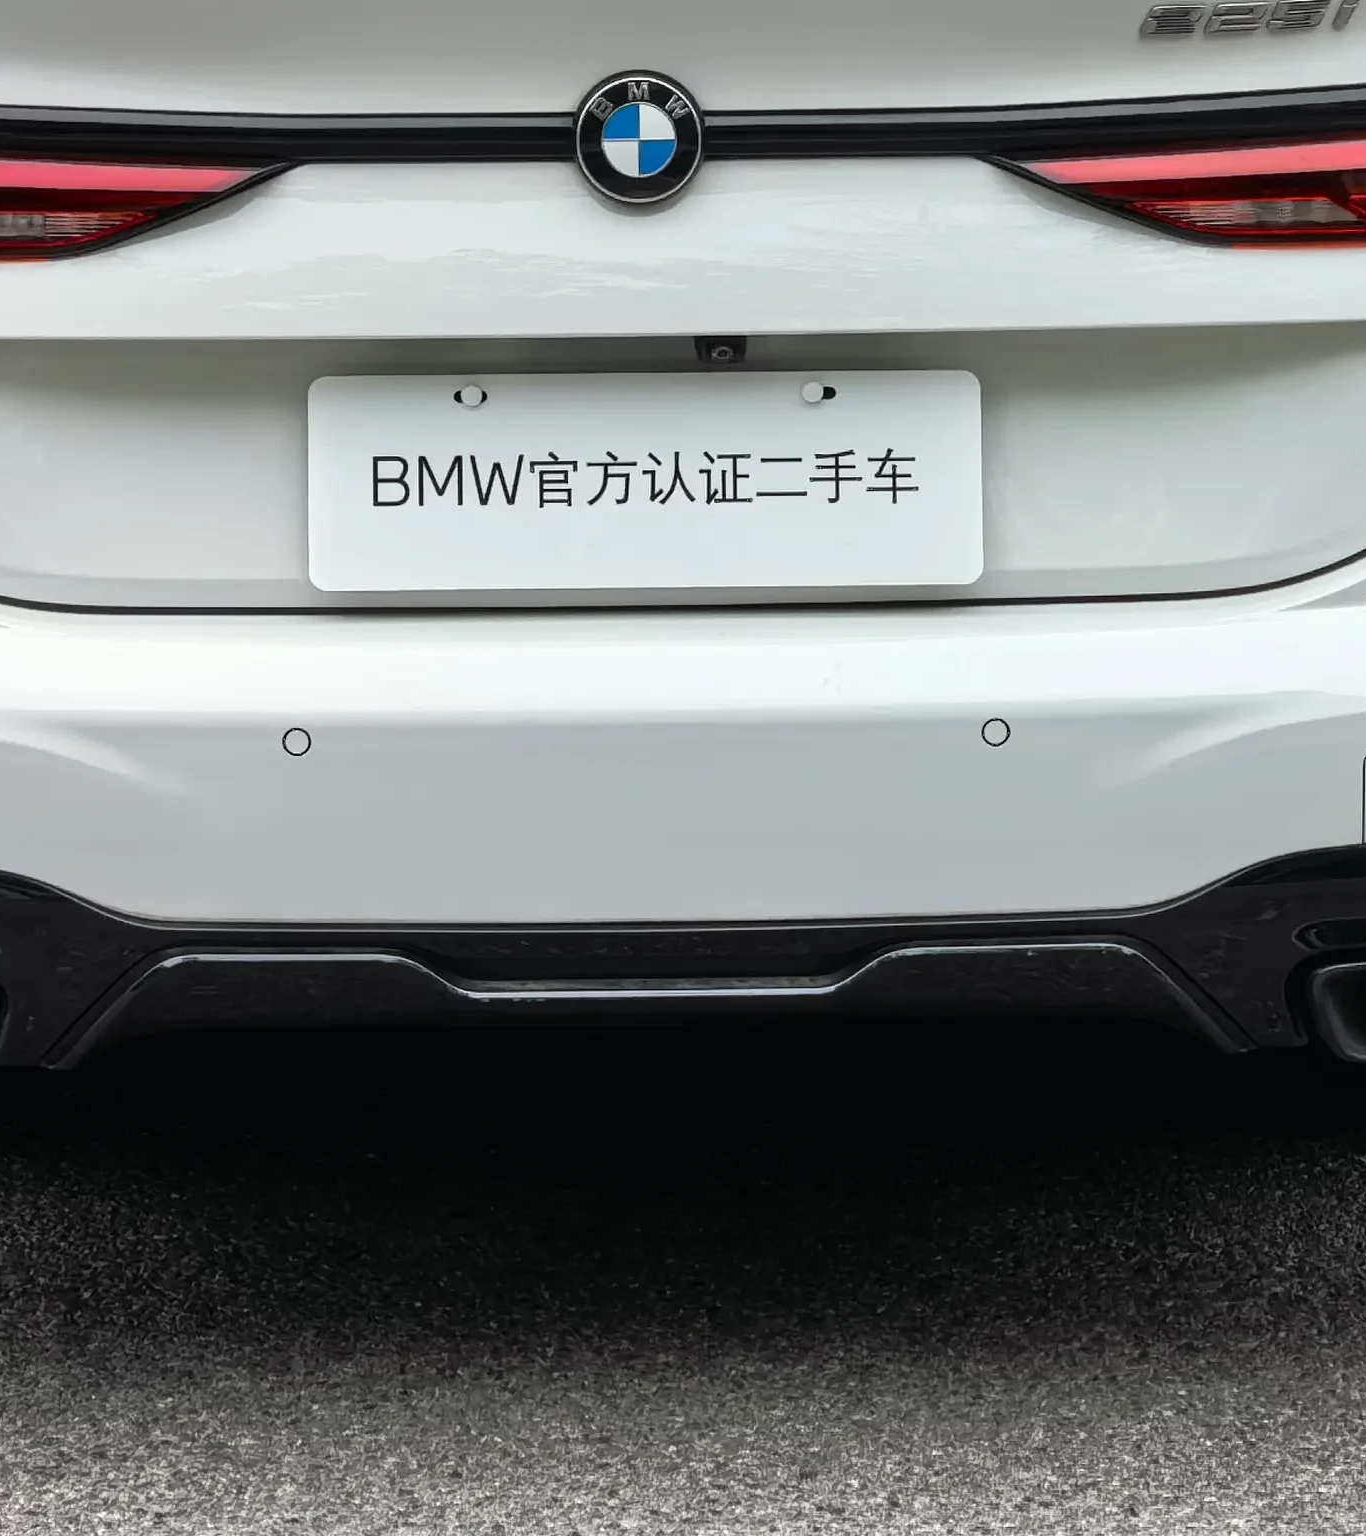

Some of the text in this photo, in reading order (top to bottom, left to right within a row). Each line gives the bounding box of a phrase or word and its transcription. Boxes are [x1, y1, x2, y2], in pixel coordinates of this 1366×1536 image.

[589, 81, 690, 121] BMW
[372, 448, 919, 508] BMW官方认证二手车
